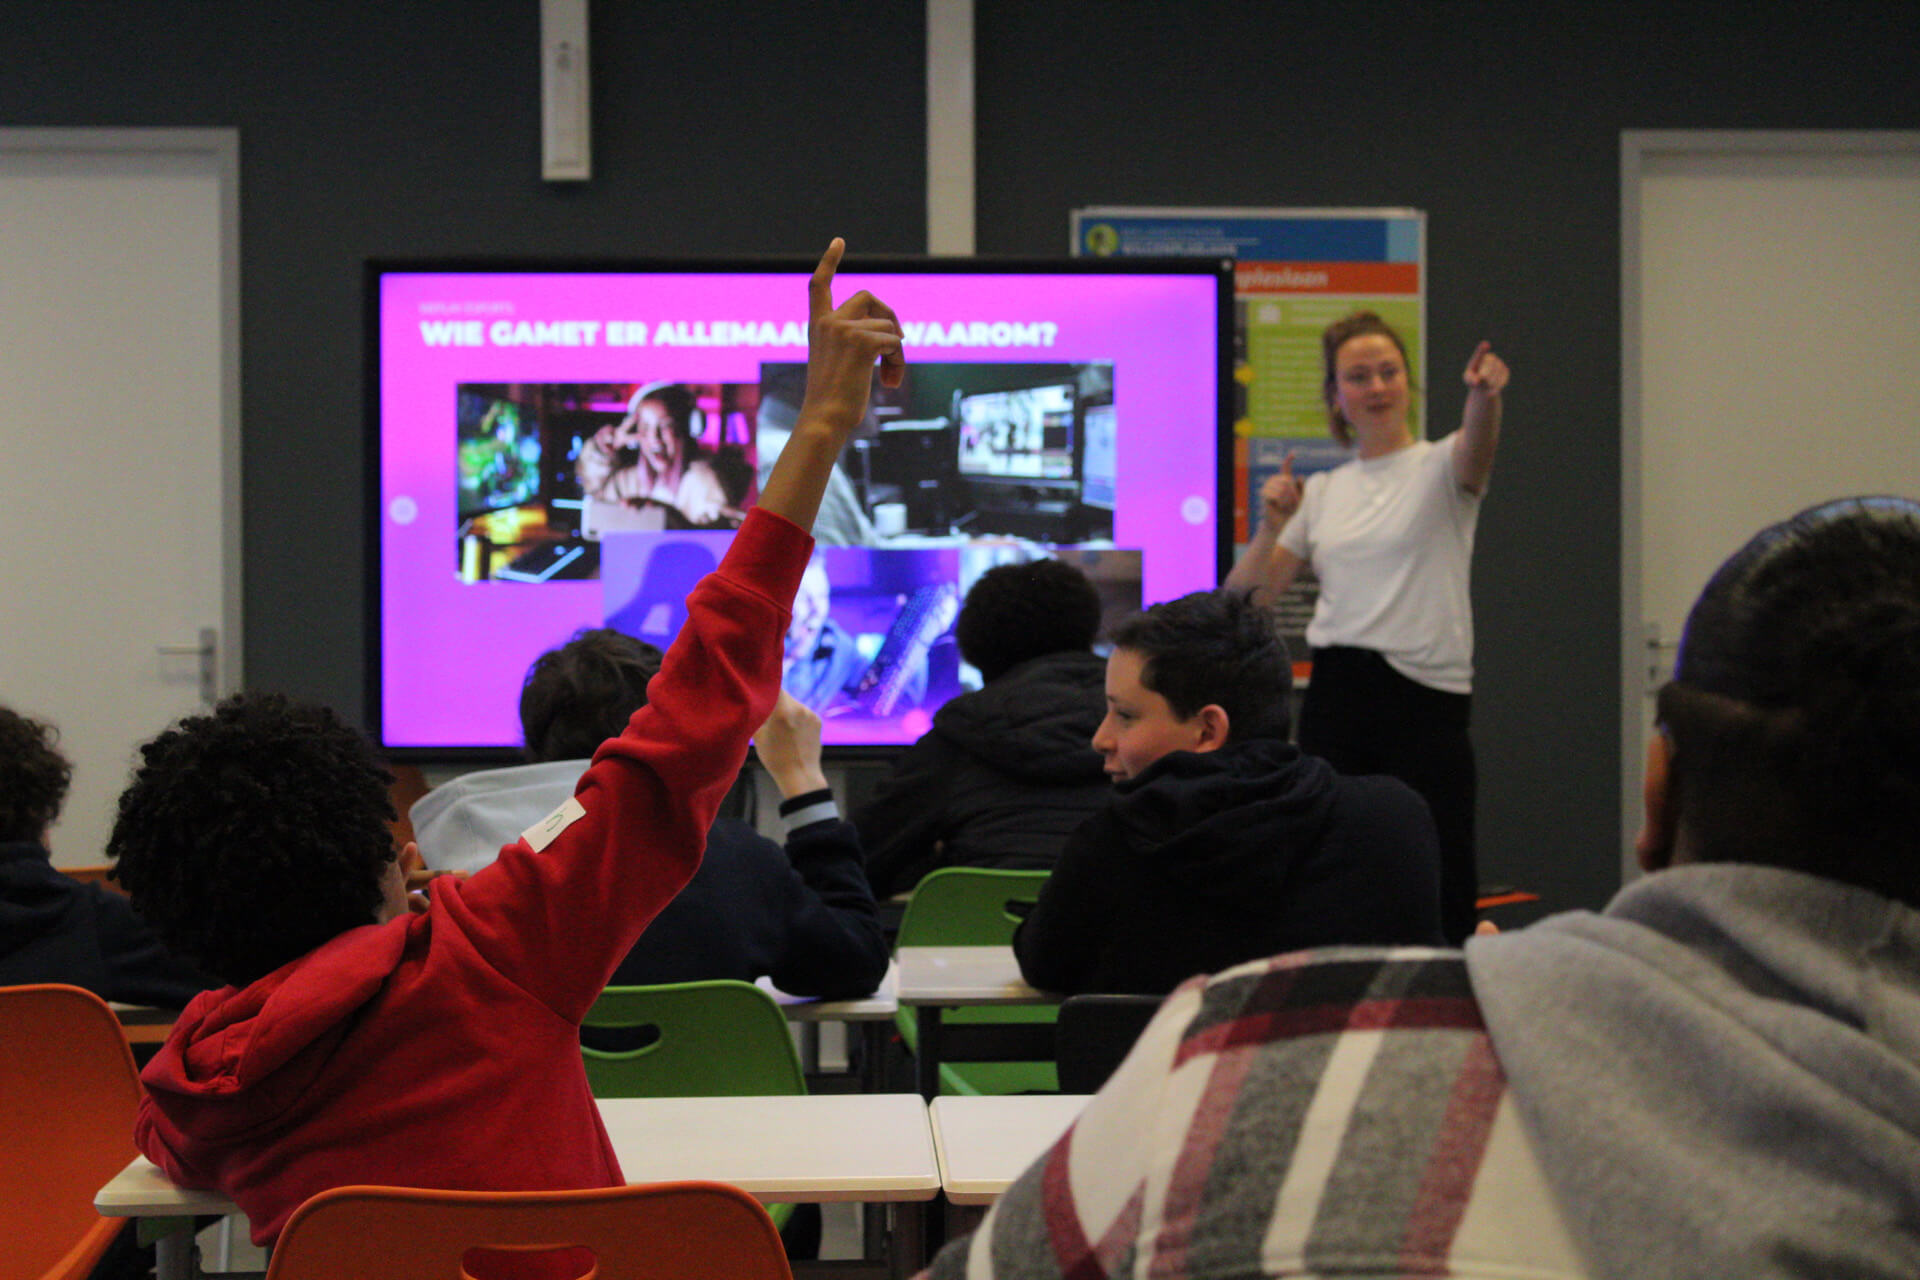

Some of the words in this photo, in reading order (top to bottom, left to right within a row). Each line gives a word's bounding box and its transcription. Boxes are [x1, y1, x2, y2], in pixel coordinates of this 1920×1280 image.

[420, 321, 484, 346] WIE
[490, 321, 600, 346] GAMET
[606, 321, 648, 346] ER
